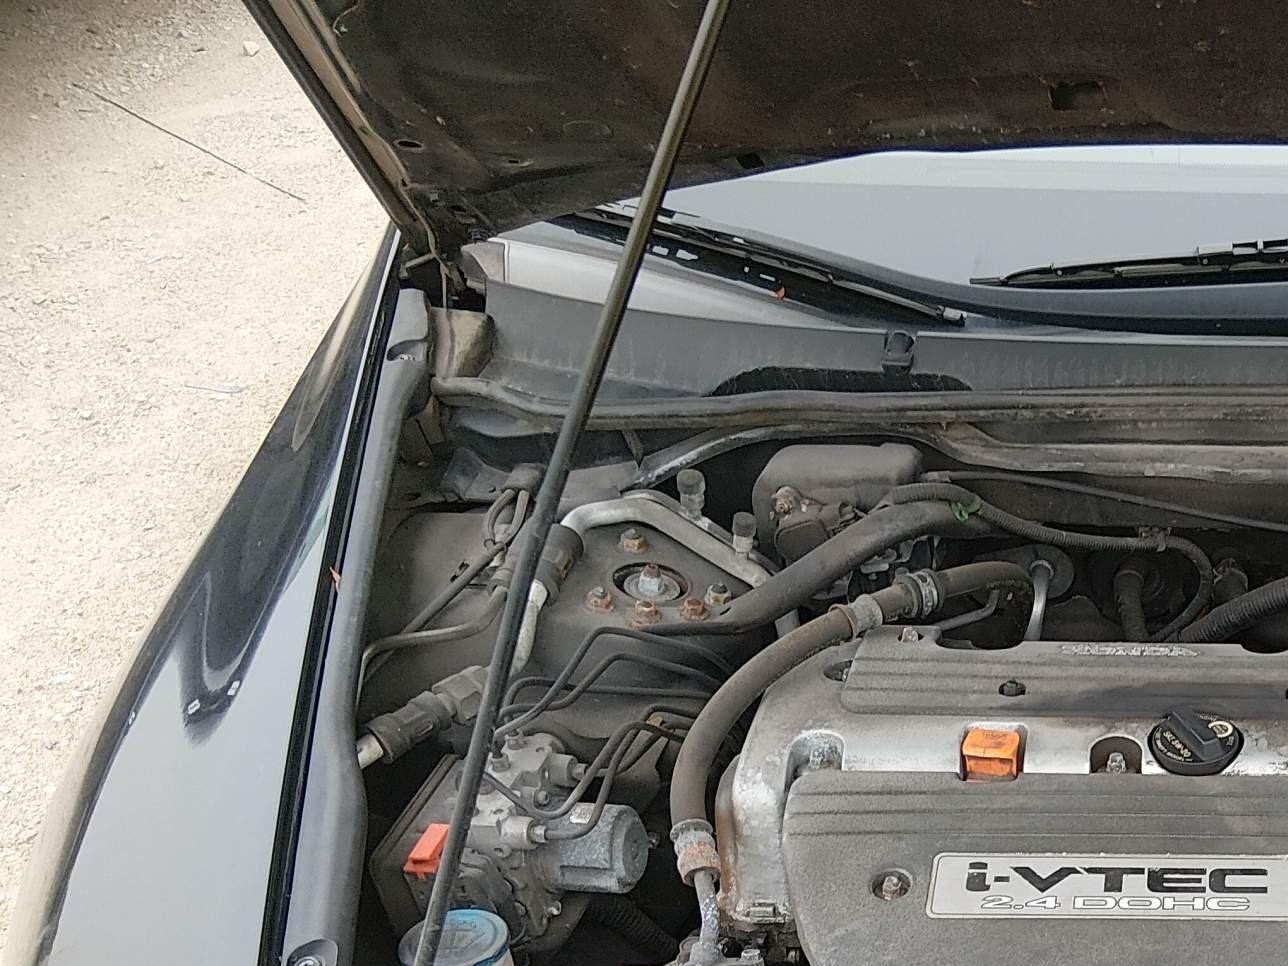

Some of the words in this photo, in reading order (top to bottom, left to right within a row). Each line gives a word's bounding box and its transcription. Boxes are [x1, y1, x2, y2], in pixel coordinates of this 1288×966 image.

[966, 862, 1269, 894] i-VTEC
[980, 895, 1061, 910] 2.4
[1073, 896, 1251, 911] DOHC
